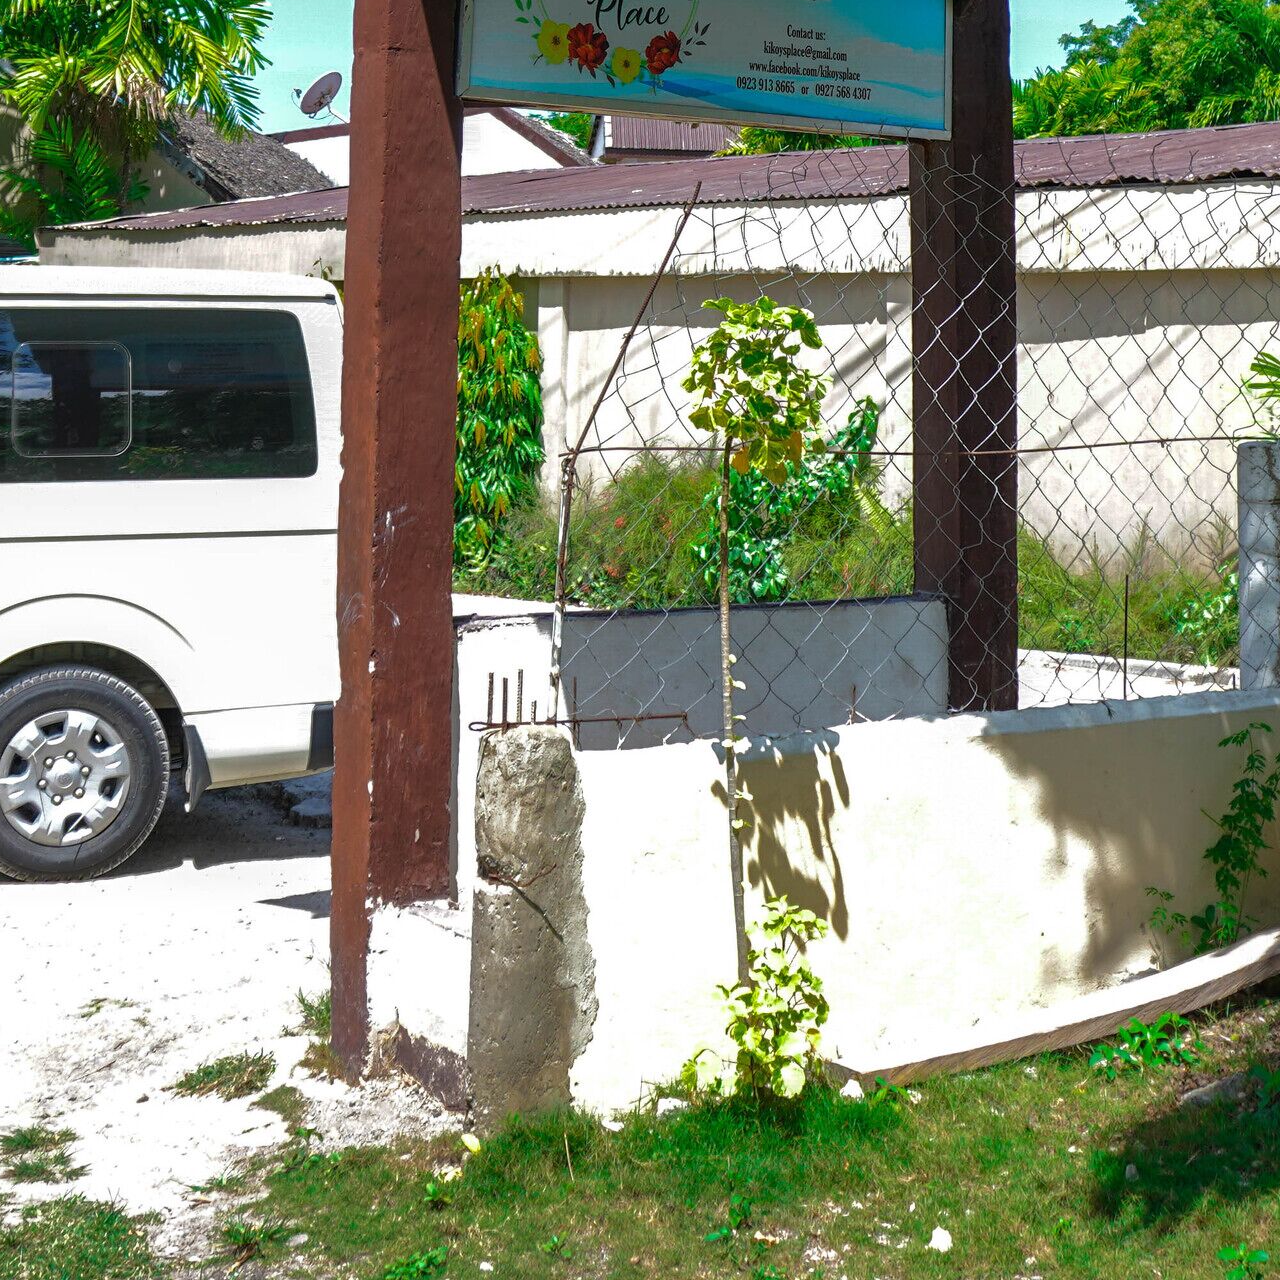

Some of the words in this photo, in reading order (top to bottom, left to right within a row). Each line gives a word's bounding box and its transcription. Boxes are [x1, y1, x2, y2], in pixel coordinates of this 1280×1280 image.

[787, 24, 813, 39] Contact
[815, 30, 826, 41] us:
[763, 40, 847, 62] kikoysplace@gmail.com
[749, 60, 861, 81] www.facebook.com/kikoysplace
[736, 76, 757, 91] 0923
[758, 78, 773, 92] 913
[775, 80, 795, 94] 8665
[801, 86, 809, 95] or
[815, 83, 834, 97] 0927
[836, 85, 851, 99] 568
[853, 87, 872, 100] 4307
